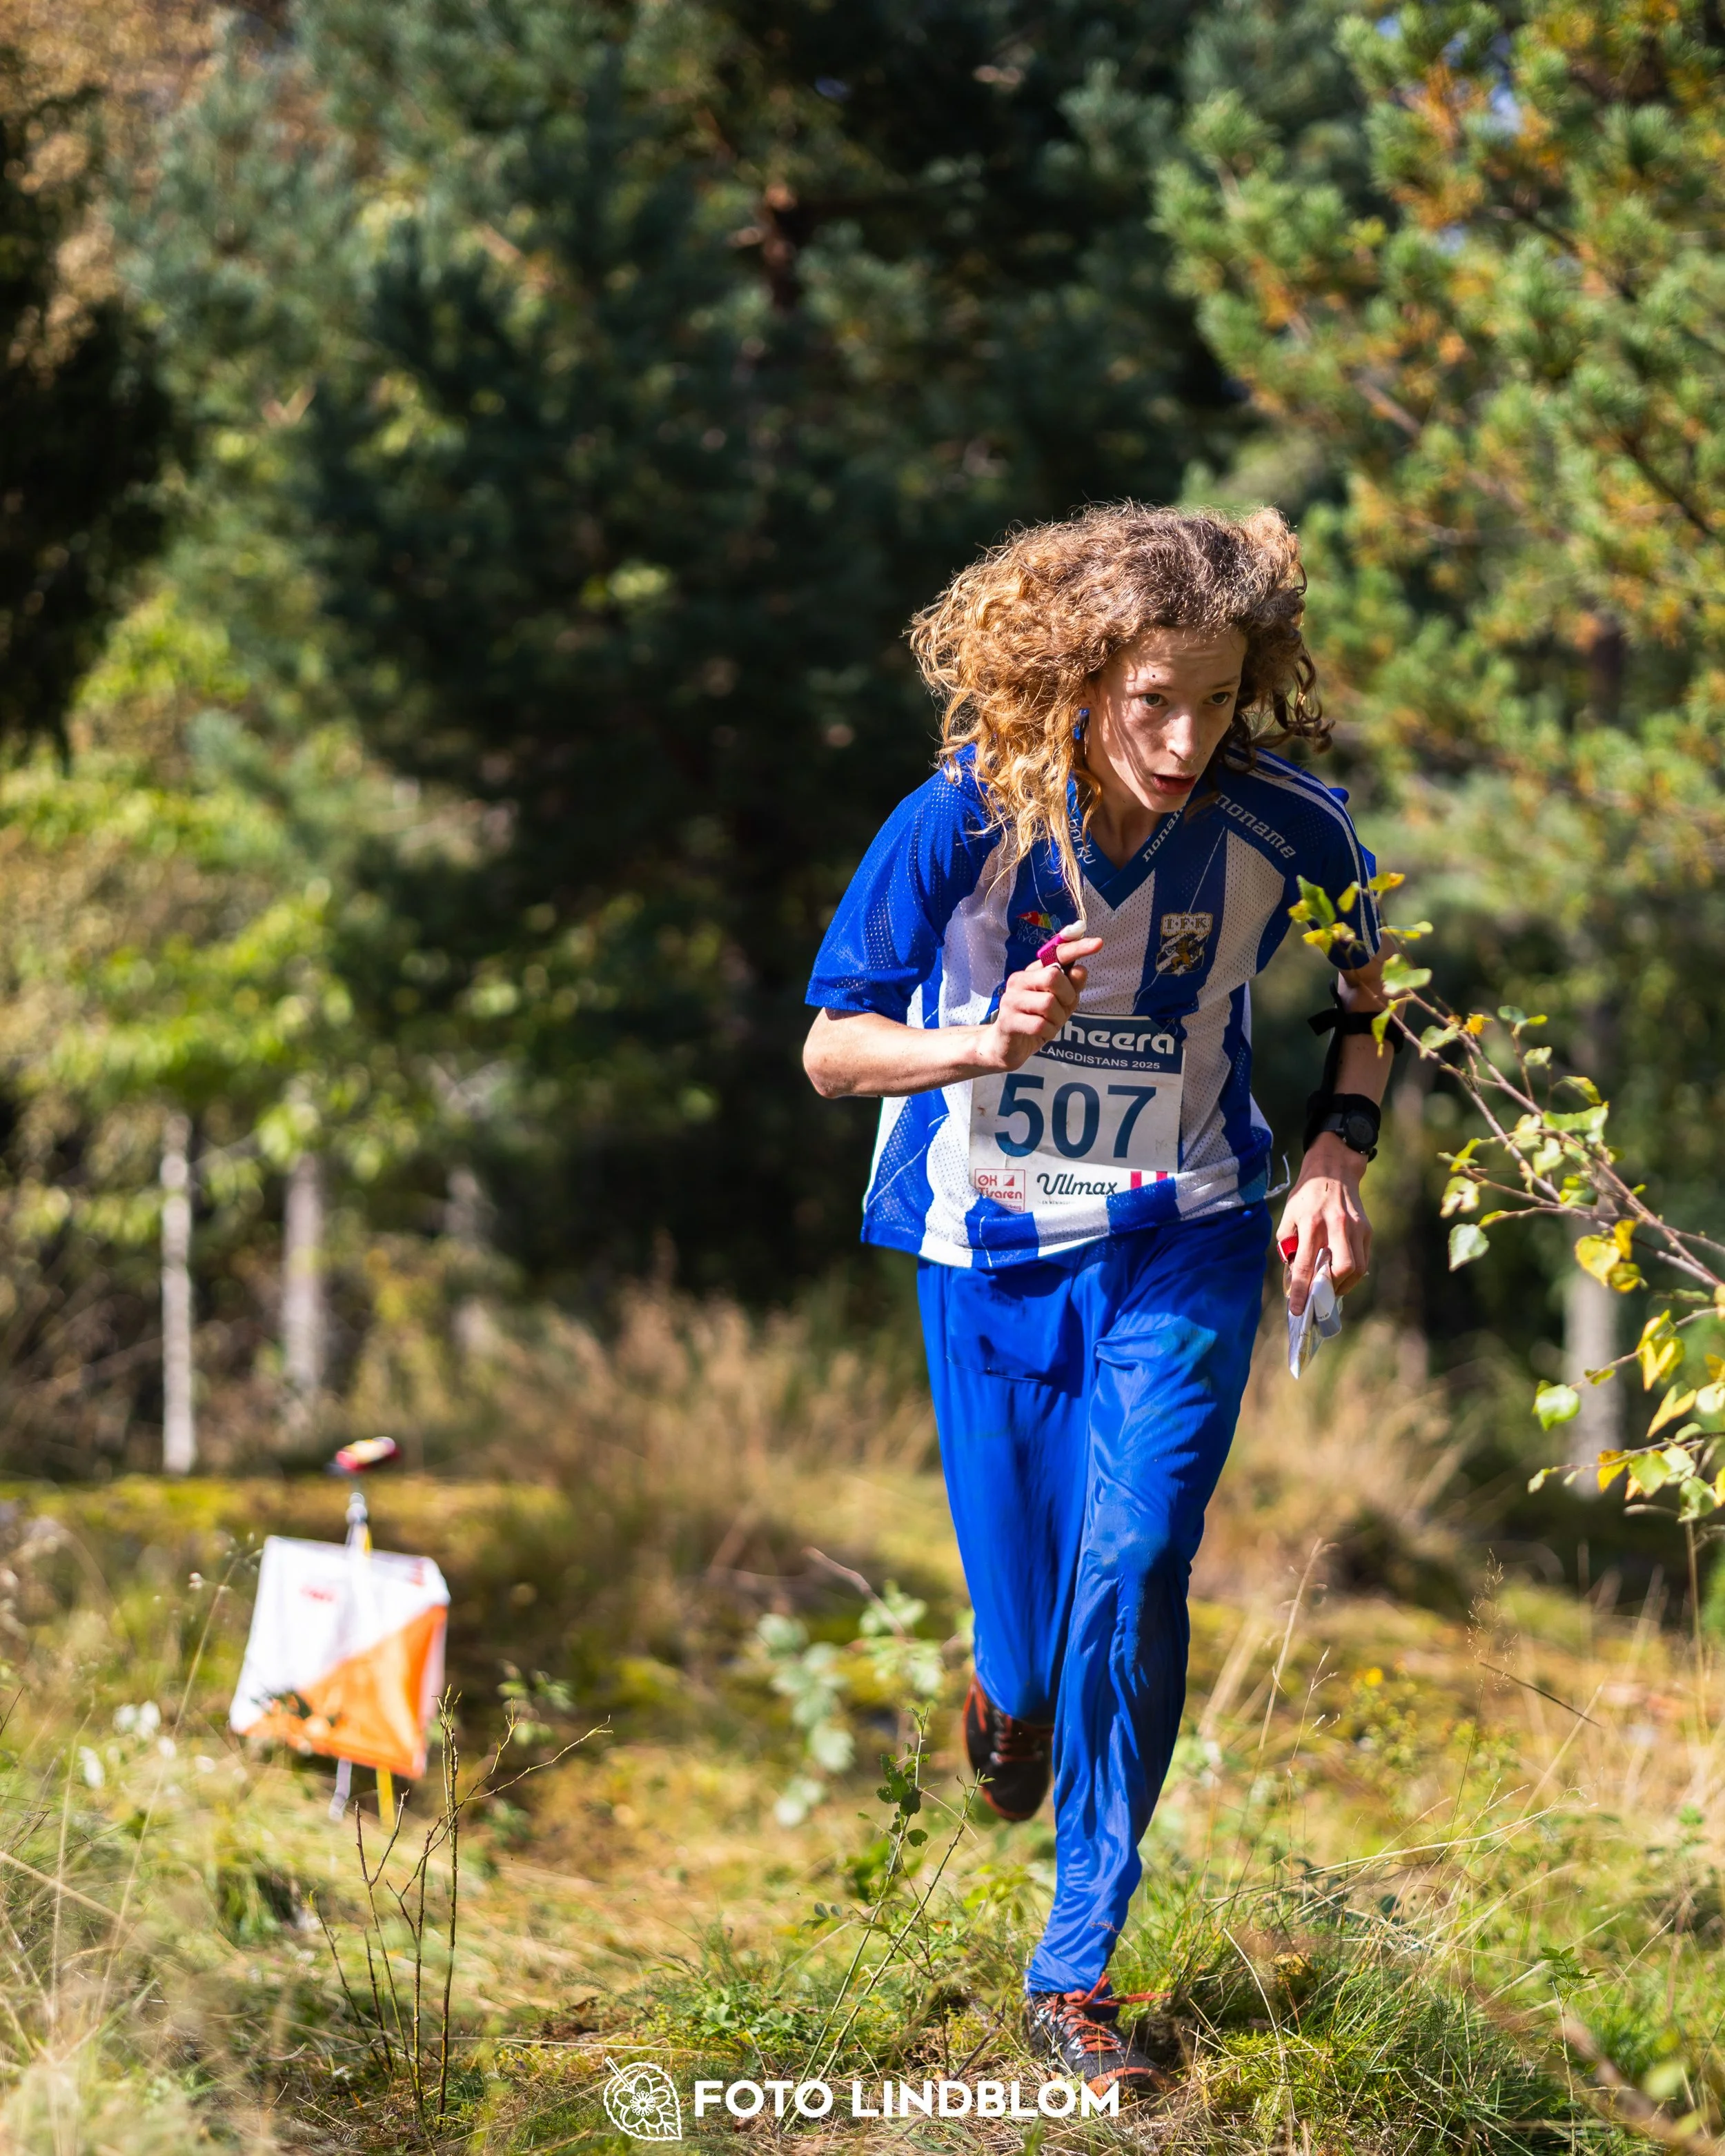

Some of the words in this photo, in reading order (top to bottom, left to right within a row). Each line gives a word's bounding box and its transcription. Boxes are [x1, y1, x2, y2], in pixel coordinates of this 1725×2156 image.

[1142, 807, 1185, 862] nona
[1214, 793, 1297, 858] noname
[1039, 1046, 1129, 1067] LÅNGDISTANS
[1132, 1060, 1161, 1069] 2025
[994, 1073, 1156, 1158] 507
[1036, 1172, 1118, 1195] Ullmax
